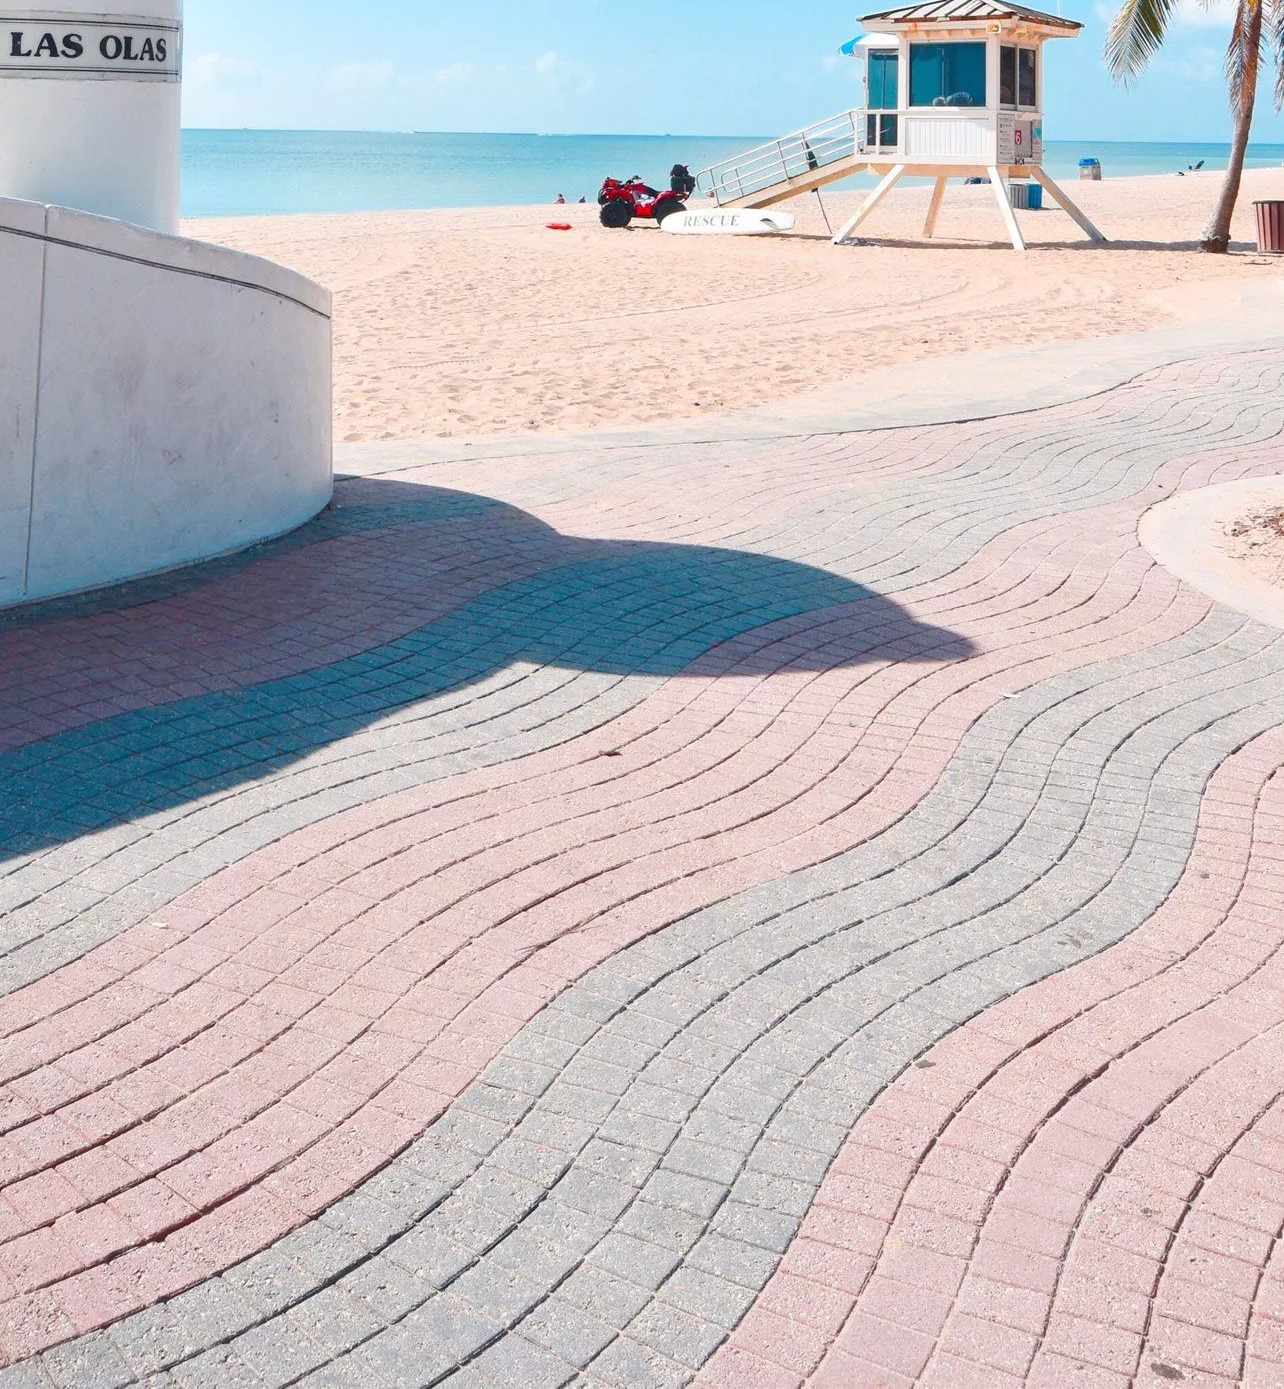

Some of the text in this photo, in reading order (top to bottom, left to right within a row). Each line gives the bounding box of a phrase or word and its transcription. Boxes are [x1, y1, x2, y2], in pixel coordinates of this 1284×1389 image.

[10, 31, 167, 62] LAS OLAS
[1015, 131, 1021, 145] 6
[683, 215, 740, 227] RESCUE
